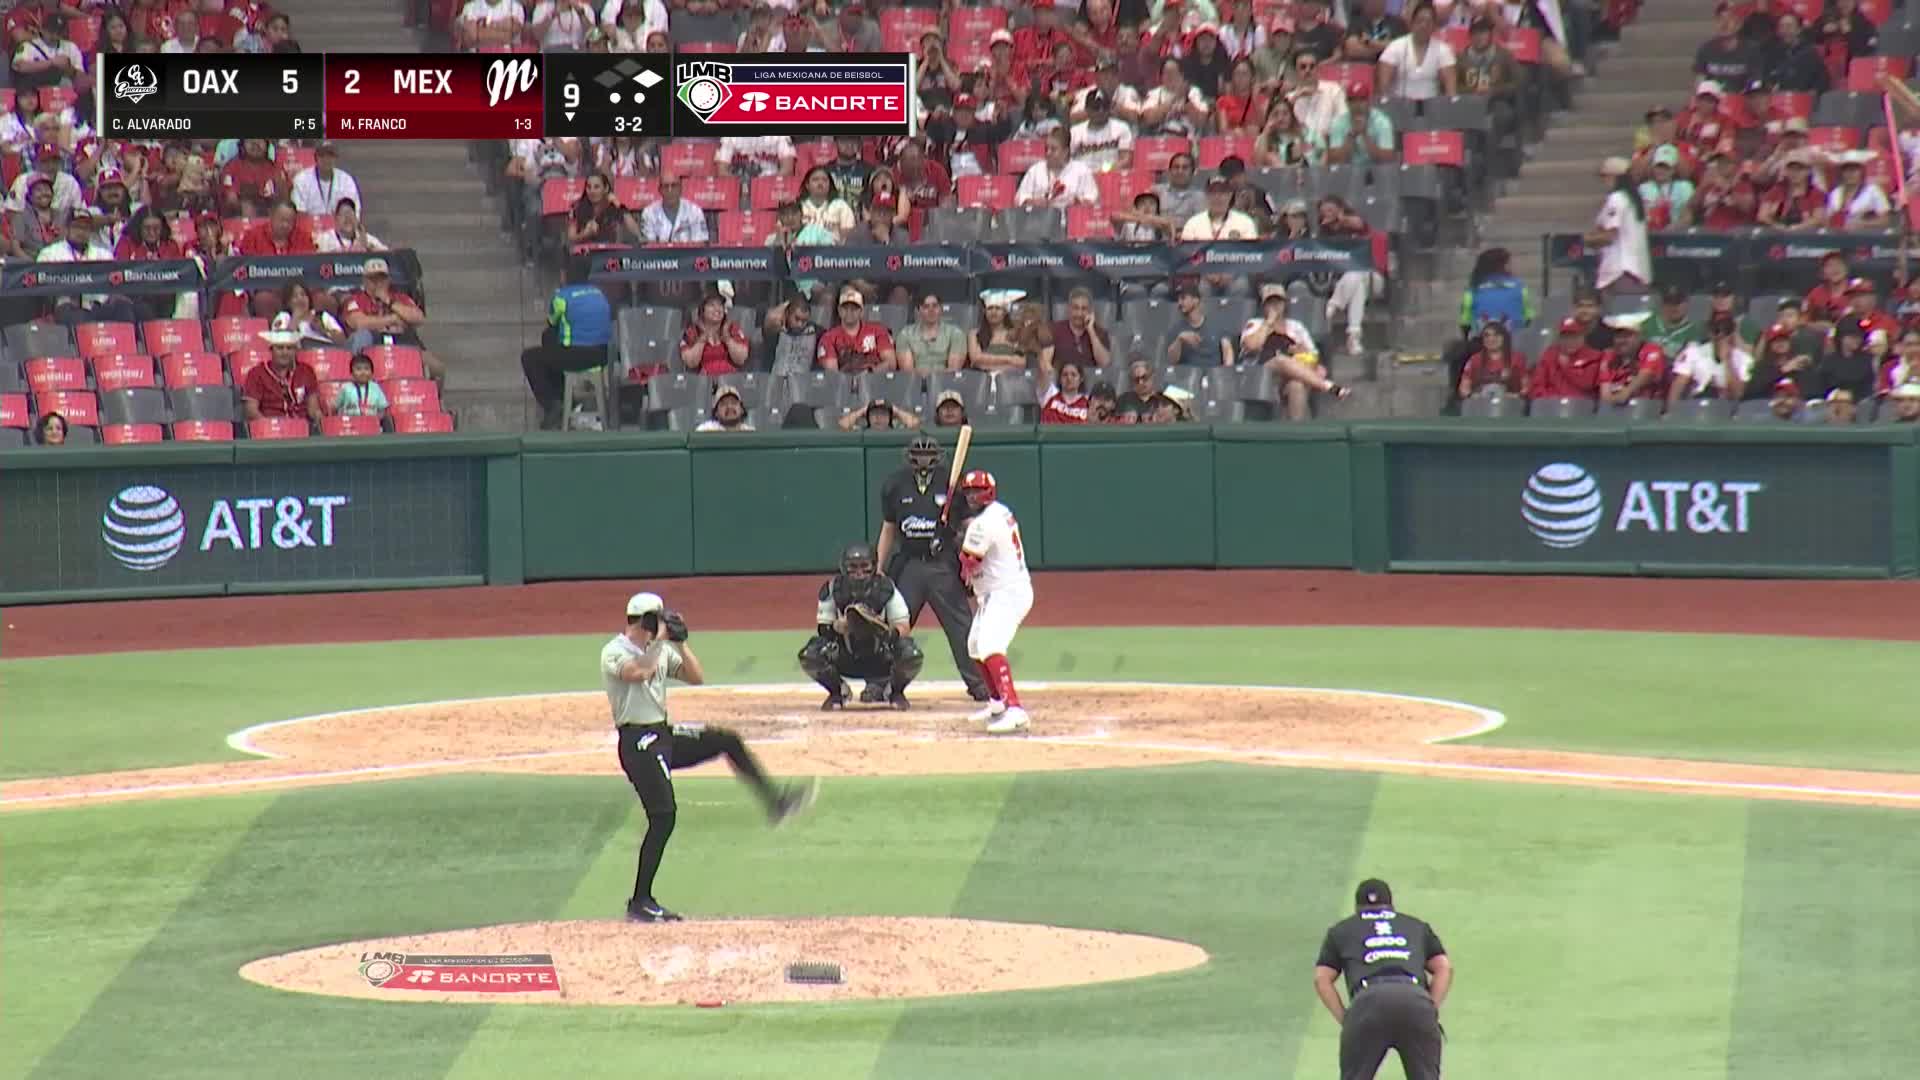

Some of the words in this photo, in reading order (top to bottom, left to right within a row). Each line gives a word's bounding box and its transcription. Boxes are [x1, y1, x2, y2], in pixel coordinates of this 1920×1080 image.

[711, 256, 767, 270] Banamex
[814, 255, 871, 269] Banamex
[903, 254, 960, 268] Banamex
[1008, 254, 1064, 267] Banamex
[1095, 253, 1152, 267] Banamex
[1206, 249, 1263, 263] Banamex
[622, 257, 679, 270] Banamex
[37, 271, 93, 284] Banamex
[124, 269, 180, 282] Banamex
[249, 265, 304, 278] Banamex
[1616, 481, 1761, 533] AT&T
[200, 495, 347, 550] AT&T
[360, 951, 405, 965] LMB
[440, 972, 553, 984] BANORTE
